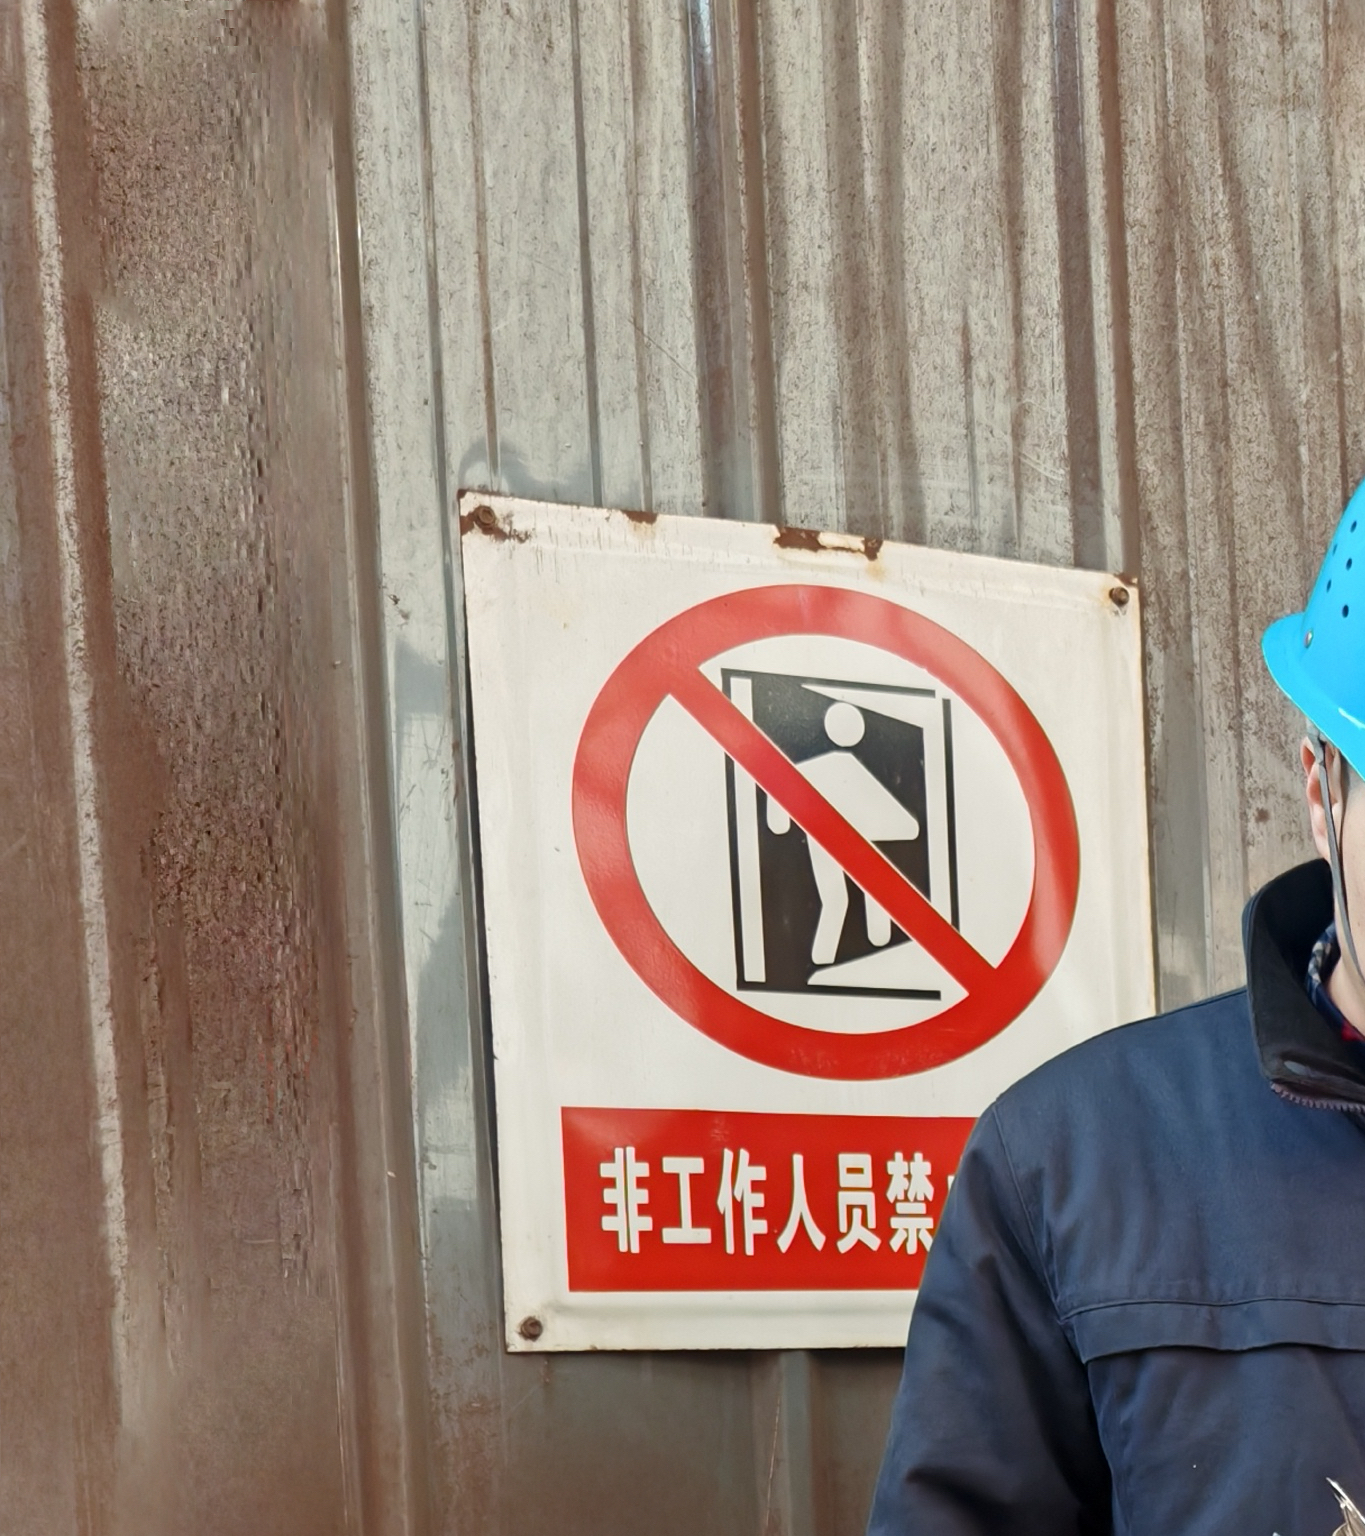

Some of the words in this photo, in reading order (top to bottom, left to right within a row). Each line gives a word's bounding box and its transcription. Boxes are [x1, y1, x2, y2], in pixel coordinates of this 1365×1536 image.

[599, 1146, 957, 1256] 非工作人员禁
